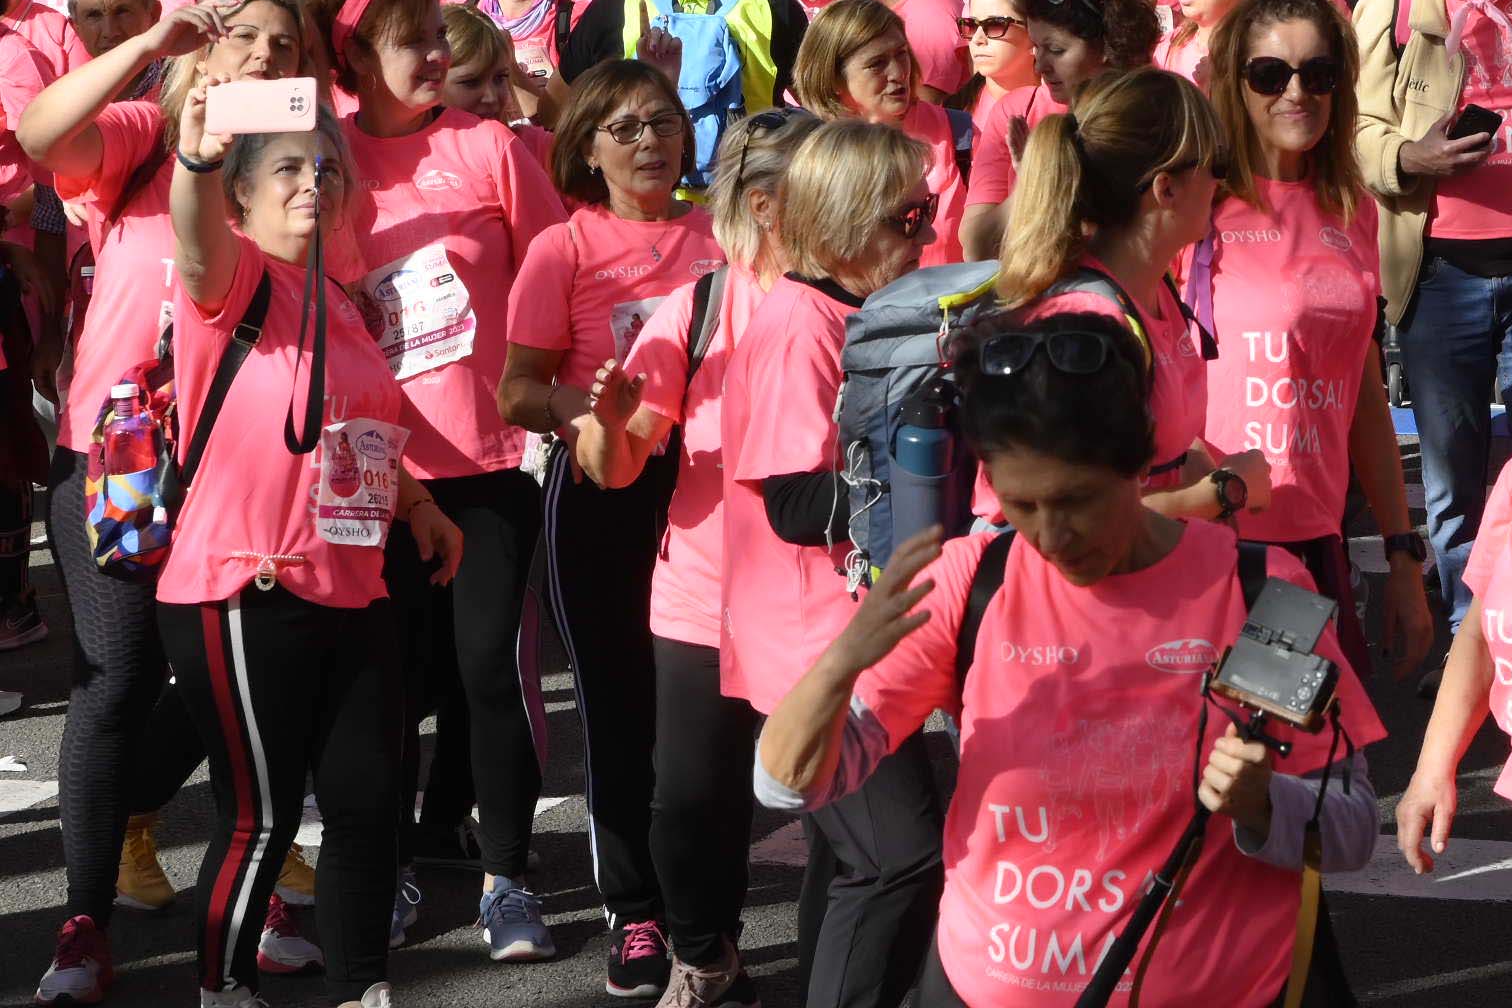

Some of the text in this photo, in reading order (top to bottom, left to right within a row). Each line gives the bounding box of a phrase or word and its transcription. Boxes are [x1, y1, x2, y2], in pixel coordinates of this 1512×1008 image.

[1221, 229, 1281, 244] OYSHO
[422, 330, 447, 345] MUJER
[1242, 330, 1289, 365] TU
[1246, 376, 1344, 411] DORSAL
[1243, 421, 1322, 456] SUMA
[364, 469, 389, 490] 016
[329, 526, 370, 538] OYSHO
[1000, 641, 1080, 666] OYSHO
[988, 803, 1050, 844] TU
[994, 861, 1150, 914] DORS
